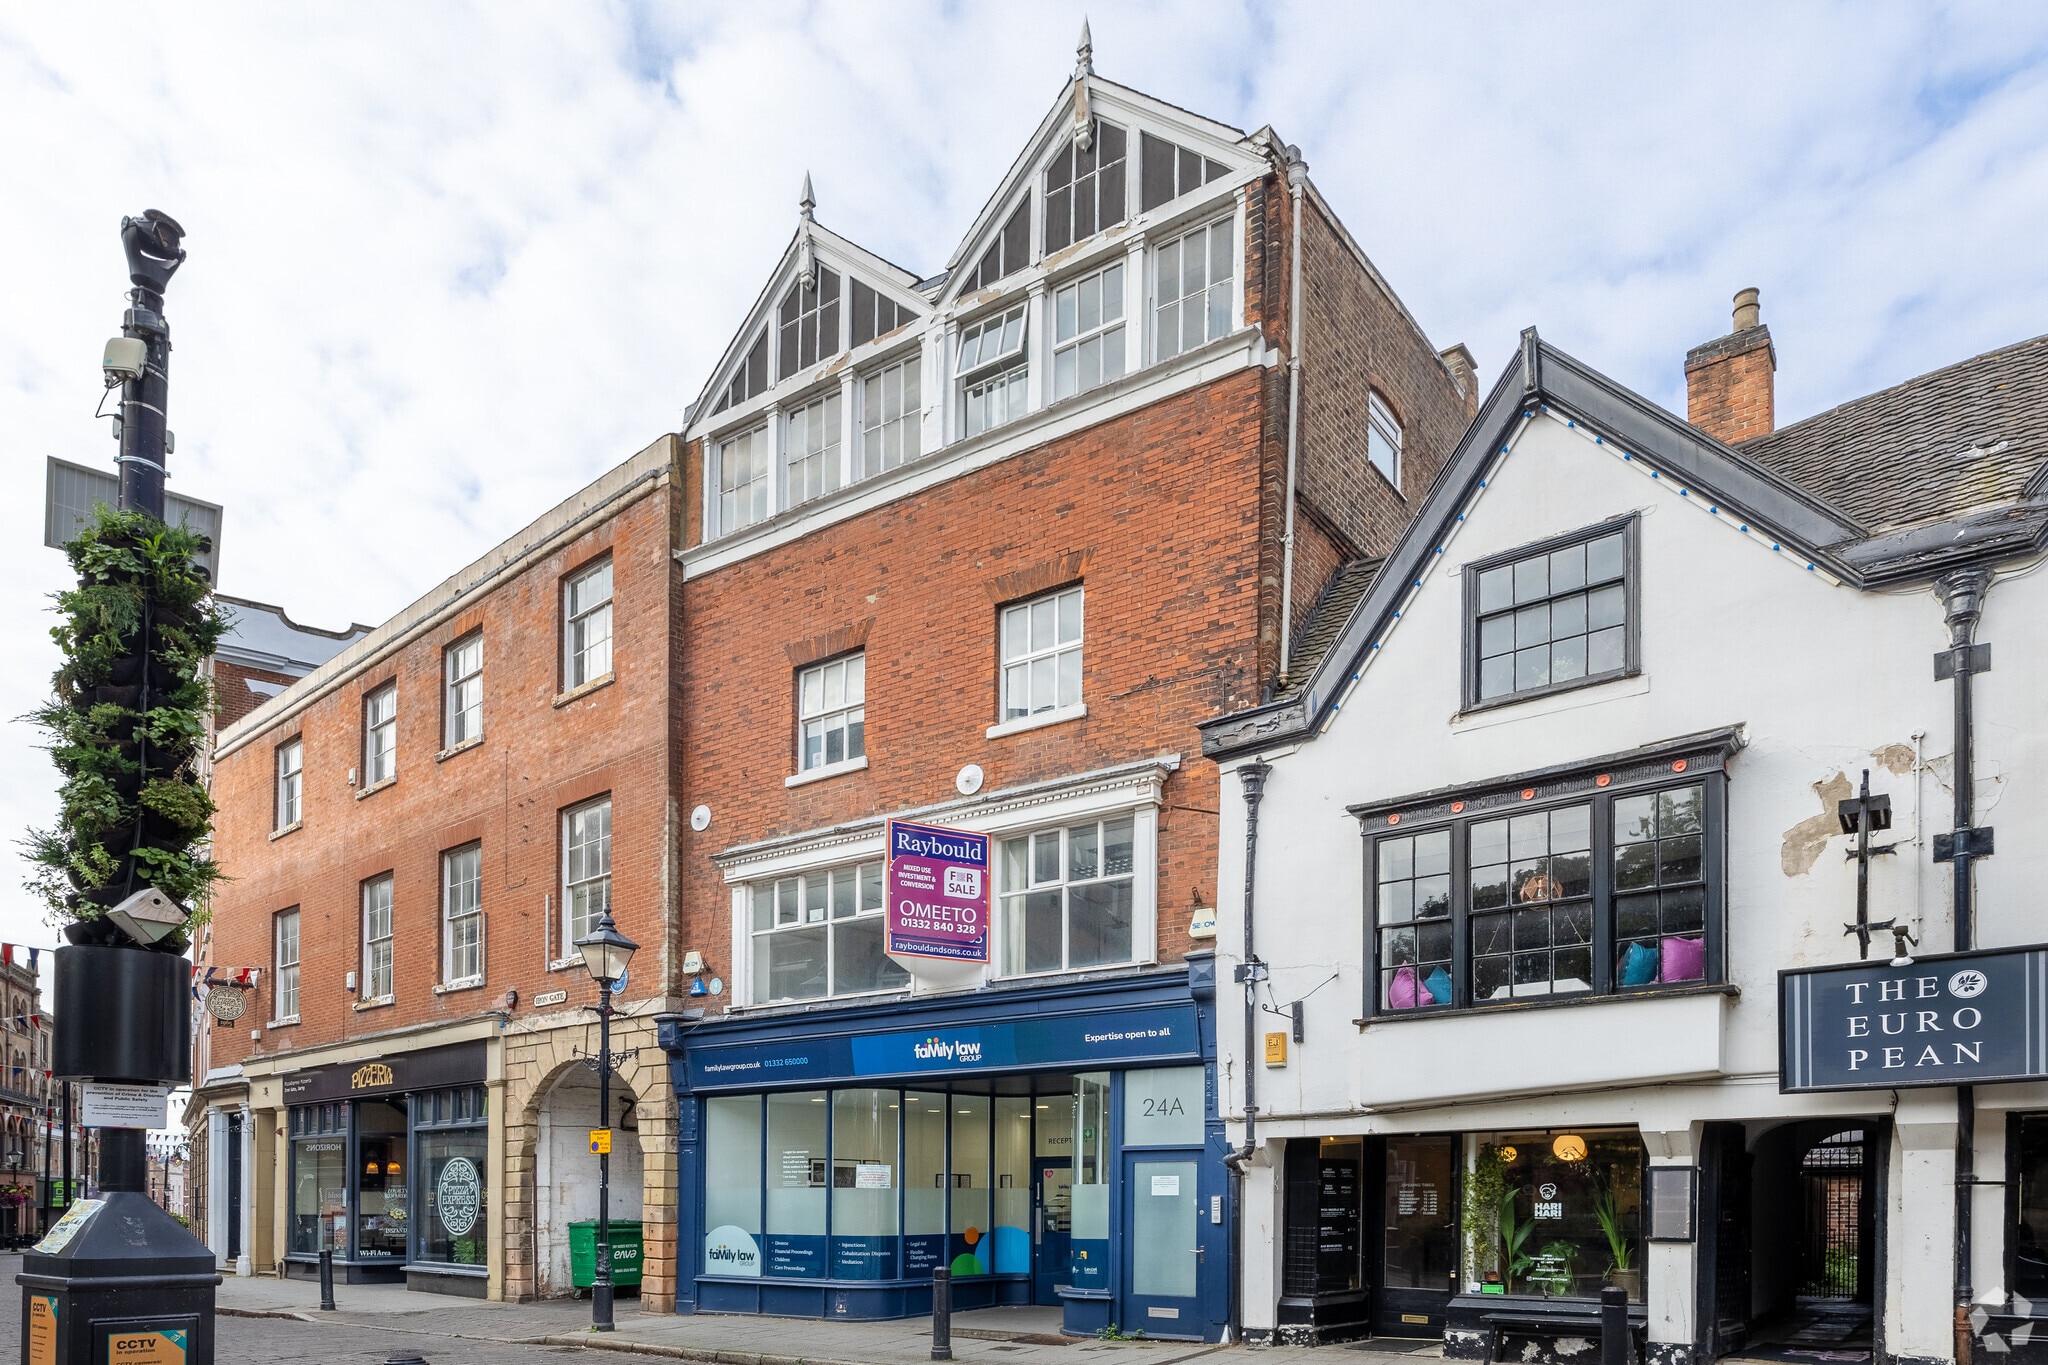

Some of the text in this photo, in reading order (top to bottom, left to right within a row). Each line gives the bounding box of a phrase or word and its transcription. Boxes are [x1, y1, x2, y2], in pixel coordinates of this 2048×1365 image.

[897, 832, 982, 860] Raybould
[903, 864, 920, 872] MIXED
[898, 872, 931, 882] INVESTMENT
[950, 871, 973, 883] FR
[900, 880, 934, 890] CONVERSION
[949, 883, 975, 895] SALE
[900, 900, 977, 923] OMEETO
[901, 918, 976, 934] 01332 840 328
[895, 942, 982, 957] raybouldandsons.co.uk
[549, 992, 565, 1001] GATE
[1845, 976, 1940, 1005] THE
[1846, 1007, 1982, 1038] EURO
[1085, 1032, 1123, 1043] Expertise
[1125, 1031, 1146, 1040] open
[1158, 1027, 1170, 1036] all
[955, 1040, 980, 1056] law
[1847, 1041, 1984, 1071] PEAN
[704, 1061, 761, 1073] familylawgroup.co.uk
[784, 1057, 808, 1066] 650000
[351, 1064, 393, 1089] PIZZERIA
[1143, 1097, 1185, 1117] 24A
[448, 1186, 469, 1195] PIZZA
[443, 1195, 475, 1204] EXPRESS
[614, 1250, 637, 1260] enva
[737, 1249, 754, 1261] law
[33, 1302, 46, 1312] CCTV
[116, 1338, 156, 1350] CCTV
